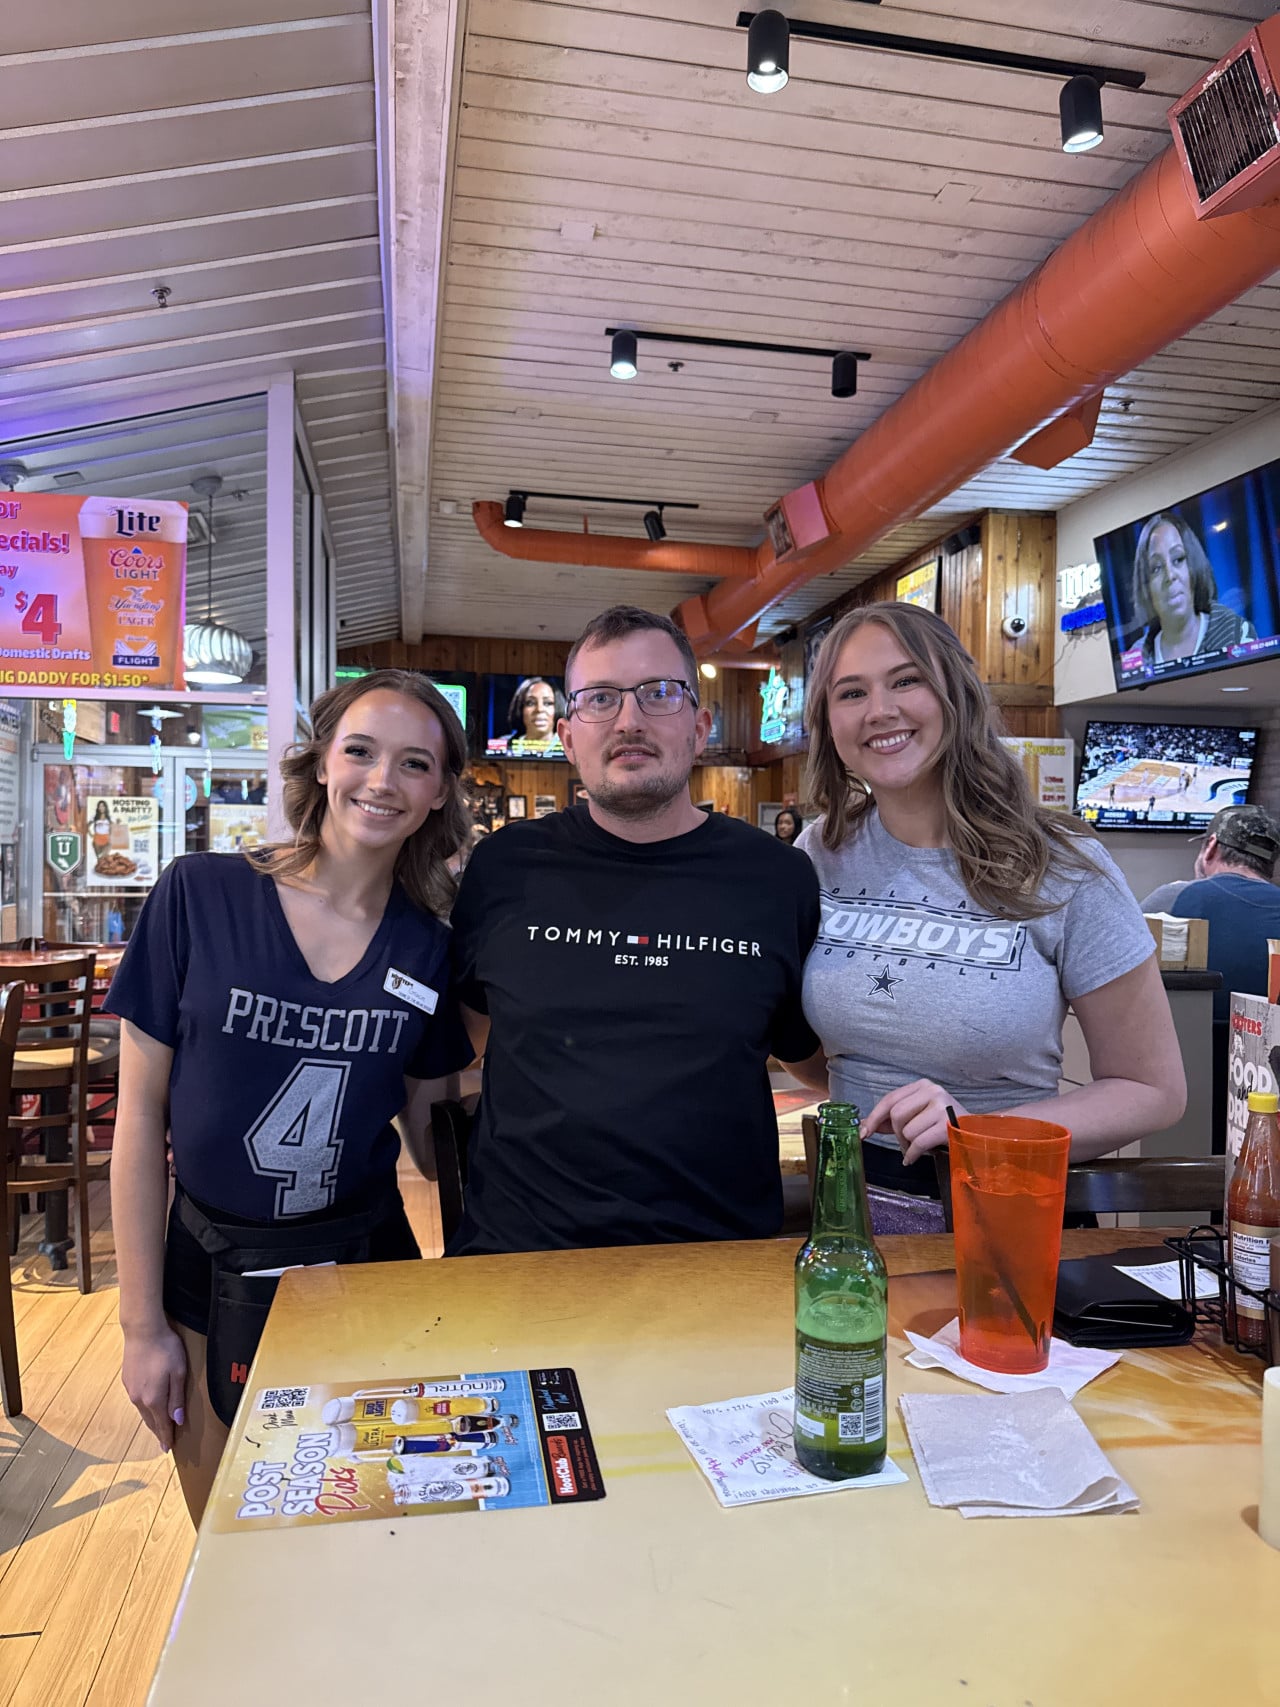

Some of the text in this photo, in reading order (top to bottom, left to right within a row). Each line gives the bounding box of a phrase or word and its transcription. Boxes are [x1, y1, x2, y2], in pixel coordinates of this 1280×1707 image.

[116, 509, 161, 537] Lite
[109, 549, 164, 570] Coors
[115, 569, 159, 580] LIGHT
[51, 650, 91, 660] Drafts
[117, 656, 154, 665] FLIGHT
[17, 671, 69, 685] DADDY
[71, 673, 101, 686] FOR
[59, 842, 70, 855] U
[528, 926, 762, 957] TOMMY HILFIGER
[614, 954, 669, 966] EST. 1985
[824, 948, 998, 980] OOTBALL
[221, 987, 410, 1054] PRESCOTT
[243, 1057, 352, 1220] 4
[1233, 1233, 1263, 1245] Nutrition
[1234, 1253, 1256, 1263] Calories
[366, 1403, 375, 1415] BUD
[374, 1400, 385, 1416] LIGHT
[369, 1427, 380, 1446] ULTRA
[281, 1432, 333, 1517] SEASON
[554, 1457, 575, 1494] HootClub
[237, 1461, 288, 1519] POST
[314, 1466, 371, 1516] Picks
